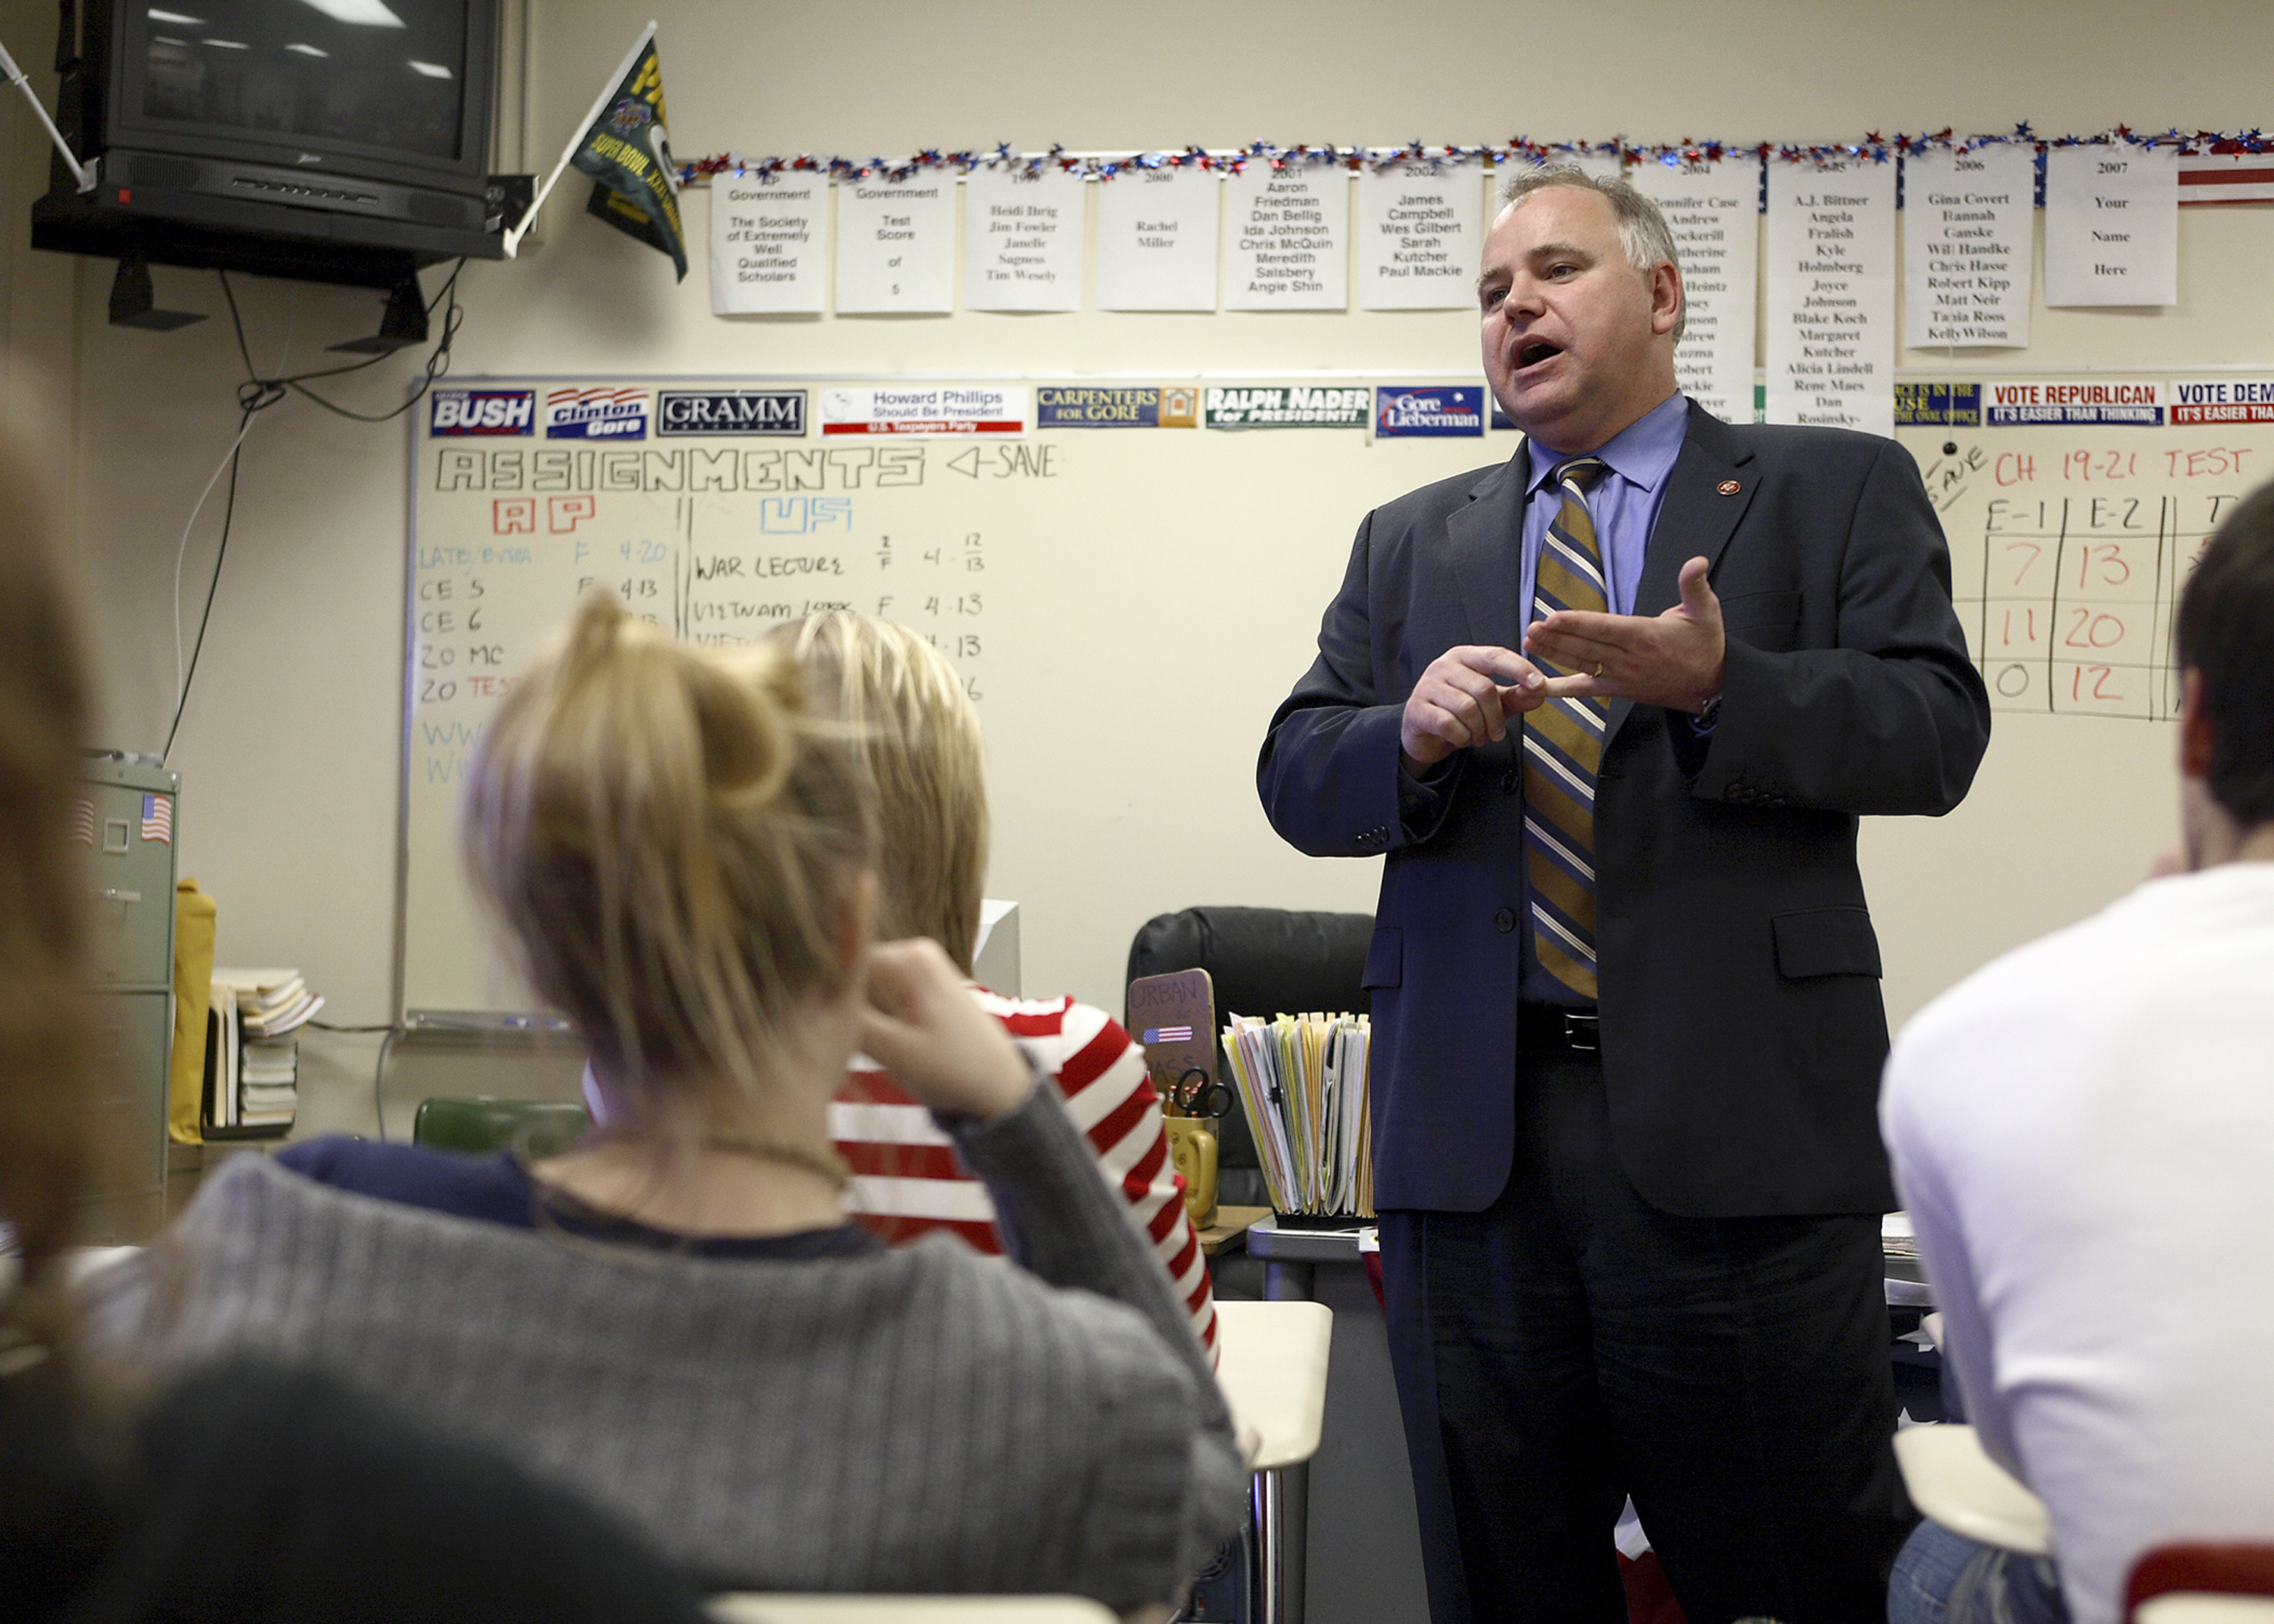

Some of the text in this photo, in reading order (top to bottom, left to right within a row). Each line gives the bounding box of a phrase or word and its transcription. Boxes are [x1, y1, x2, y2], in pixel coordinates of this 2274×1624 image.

[590, 133, 650, 177] SUPER BOWL
[1682, 164, 1711, 175] 2004
[1955, 160, 1984, 171] 2006
[2097, 162, 2128, 174] 2007
[1145, 173, 1173, 183] 2000
[1272, 167, 1302, 179] 2001
[1406, 167, 1437, 177] 2002
[1267, 183, 1308, 192] Aaron
[730, 189, 810, 200] Government
[857, 189, 938, 199] Government
[1928, 193, 2009, 205] Gina Covert
[1255, 197, 1320, 207] Friedman
[1399, 196, 1444, 205] James
[1708, 196, 1739, 208] Case
[1795, 196, 1869, 207] A.J. Bittner
[2094, 197, 2128, 209] Your
[991, 205, 1058, 219] Heidi Ihrig
[1253, 211, 1322, 224] Dan Bellig
[1389, 208, 1454, 222] Campbell
[1809, 212, 1854, 224] Angela
[1943, 211, 1995, 221] Hannah
[731, 217, 809, 230] The Society
[882, 215, 911, 226] Test
[1672, 214, 1719, 224] Andrew
[989, 222, 1057, 233] Jim Fowler
[1136, 221, 1178, 231] Rachel
[1245, 226, 1329, 235] Ida Johnson
[1382, 223, 1461, 234] Wes Gilbert
[728, 230, 810, 243] of Extremely
[877, 230, 915, 240] Score
[1809, 229, 1854, 239] Fralish
[1944, 227, 1994, 239] Ganske
[2091, 231, 2130, 243] Name
[1004, 238, 1048, 248] Janelle
[1139, 237, 1175, 248] Miller
[1240, 239, 1333, 250] Chris McQuin
[1402, 237, 1441, 248] Sarah
[755, 245, 782, 255] Well
[1816, 246, 1846, 258] Kyle
[1928, 243, 2010, 255] Will Handke
[888, 257, 901, 267] of
[999, 254, 1046, 266] Sagness
[1256, 253, 1316, 264] Meredith
[1394, 252, 1448, 262] Kutcher
[738, 258, 797, 269] Qualified
[1799, 262, 1863, 274] Holmberg
[1929, 260, 2008, 272] Chris Hasse
[1256, 268, 1316, 280] Salsbery
[1380, 266, 1463, 277] Paul Mackie
[2094, 264, 2128, 276] Here
[738, 271, 796, 282] Scholars
[986, 270, 1056, 283] Tim Wesely
[892, 285, 900, 295] 5
[1248, 282, 1323, 294] Angie Shin
[1686, 281, 1727, 293] Heintz
[1812, 280, 1849, 293] Joyce
[1928, 277, 2010, 291] Robert Kipp
[1803, 297, 1857, 308] Johnson
[1937, 294, 1968, 305] Matt
[1793, 314, 1867, 324] Blake Koch
[1973, 311, 2005, 322] Roos
[1799, 330, 1860, 343] Margaret
[1803, 347, 1856, 358] Kutcher
[1787, 363, 1873, 374] Alicia Lindell
[1795, 380, 1865, 391] Rene Maes
[1934, 384, 1975, 397] IN THE
[874, 390, 1003, 406] Howard Phillips
[1038, 390, 1157, 405] CARPENTERS
[1207, 386, 1369, 411] RALPH NADER
[1995, 386, 2155, 405] VOTE REPUBLICAN
[2178, 384, 2227, 402] VOTE
[1395, 393, 1442, 412] Gore
[1816, 397, 1842, 408] Dan
[434, 398, 533, 427] BUSH
[553, 401, 641, 424] Clinton
[666, 398, 798, 423] GRAMM
[873, 406, 1004, 417] Should Be President
[1056, 405, 1140, 421] FOR GORE
[1215, 409, 1358, 423] for PRESIDENT!
[1994, 407, 2157, 421] IT'S EASIER THAN THINKING
[2178, 405, 2247, 421] IT'S EASIER
[1386, 411, 1480, 427] Lieberman
[587, 418, 642, 436] Gore
[867, 421, 979, 433] U.S. Taxpayers Party
[994, 444, 1057, 477] SAVE
[1995, 446, 2253, 487] CH 19-21 TEST
[437, 446, 926, 493] ASSIGNMENTS
[493, 493, 596, 535] AP
[761, 496, 852, 534] US
[1987, 498, 2142, 530] E-1 E-2
[965, 533, 982, 547] 12
[575, 541, 590, 565] F
[696, 547, 941, 580] WAR LECTURE 4
[966, 558, 985, 571] 13
[2006, 542, 2130, 589] 7 13
[420, 577, 595, 601] CE 5 F
[694, 603, 791, 621] VIETNAM
[878, 596, 894, 616] F
[420, 609, 482, 633] CE 6
[2003, 608, 2125, 648] 11 20
[470, 645, 504, 665] MC
[1997, 664, 2123, 702] 0 12
[1130, 980, 1197, 1009] URBAN
